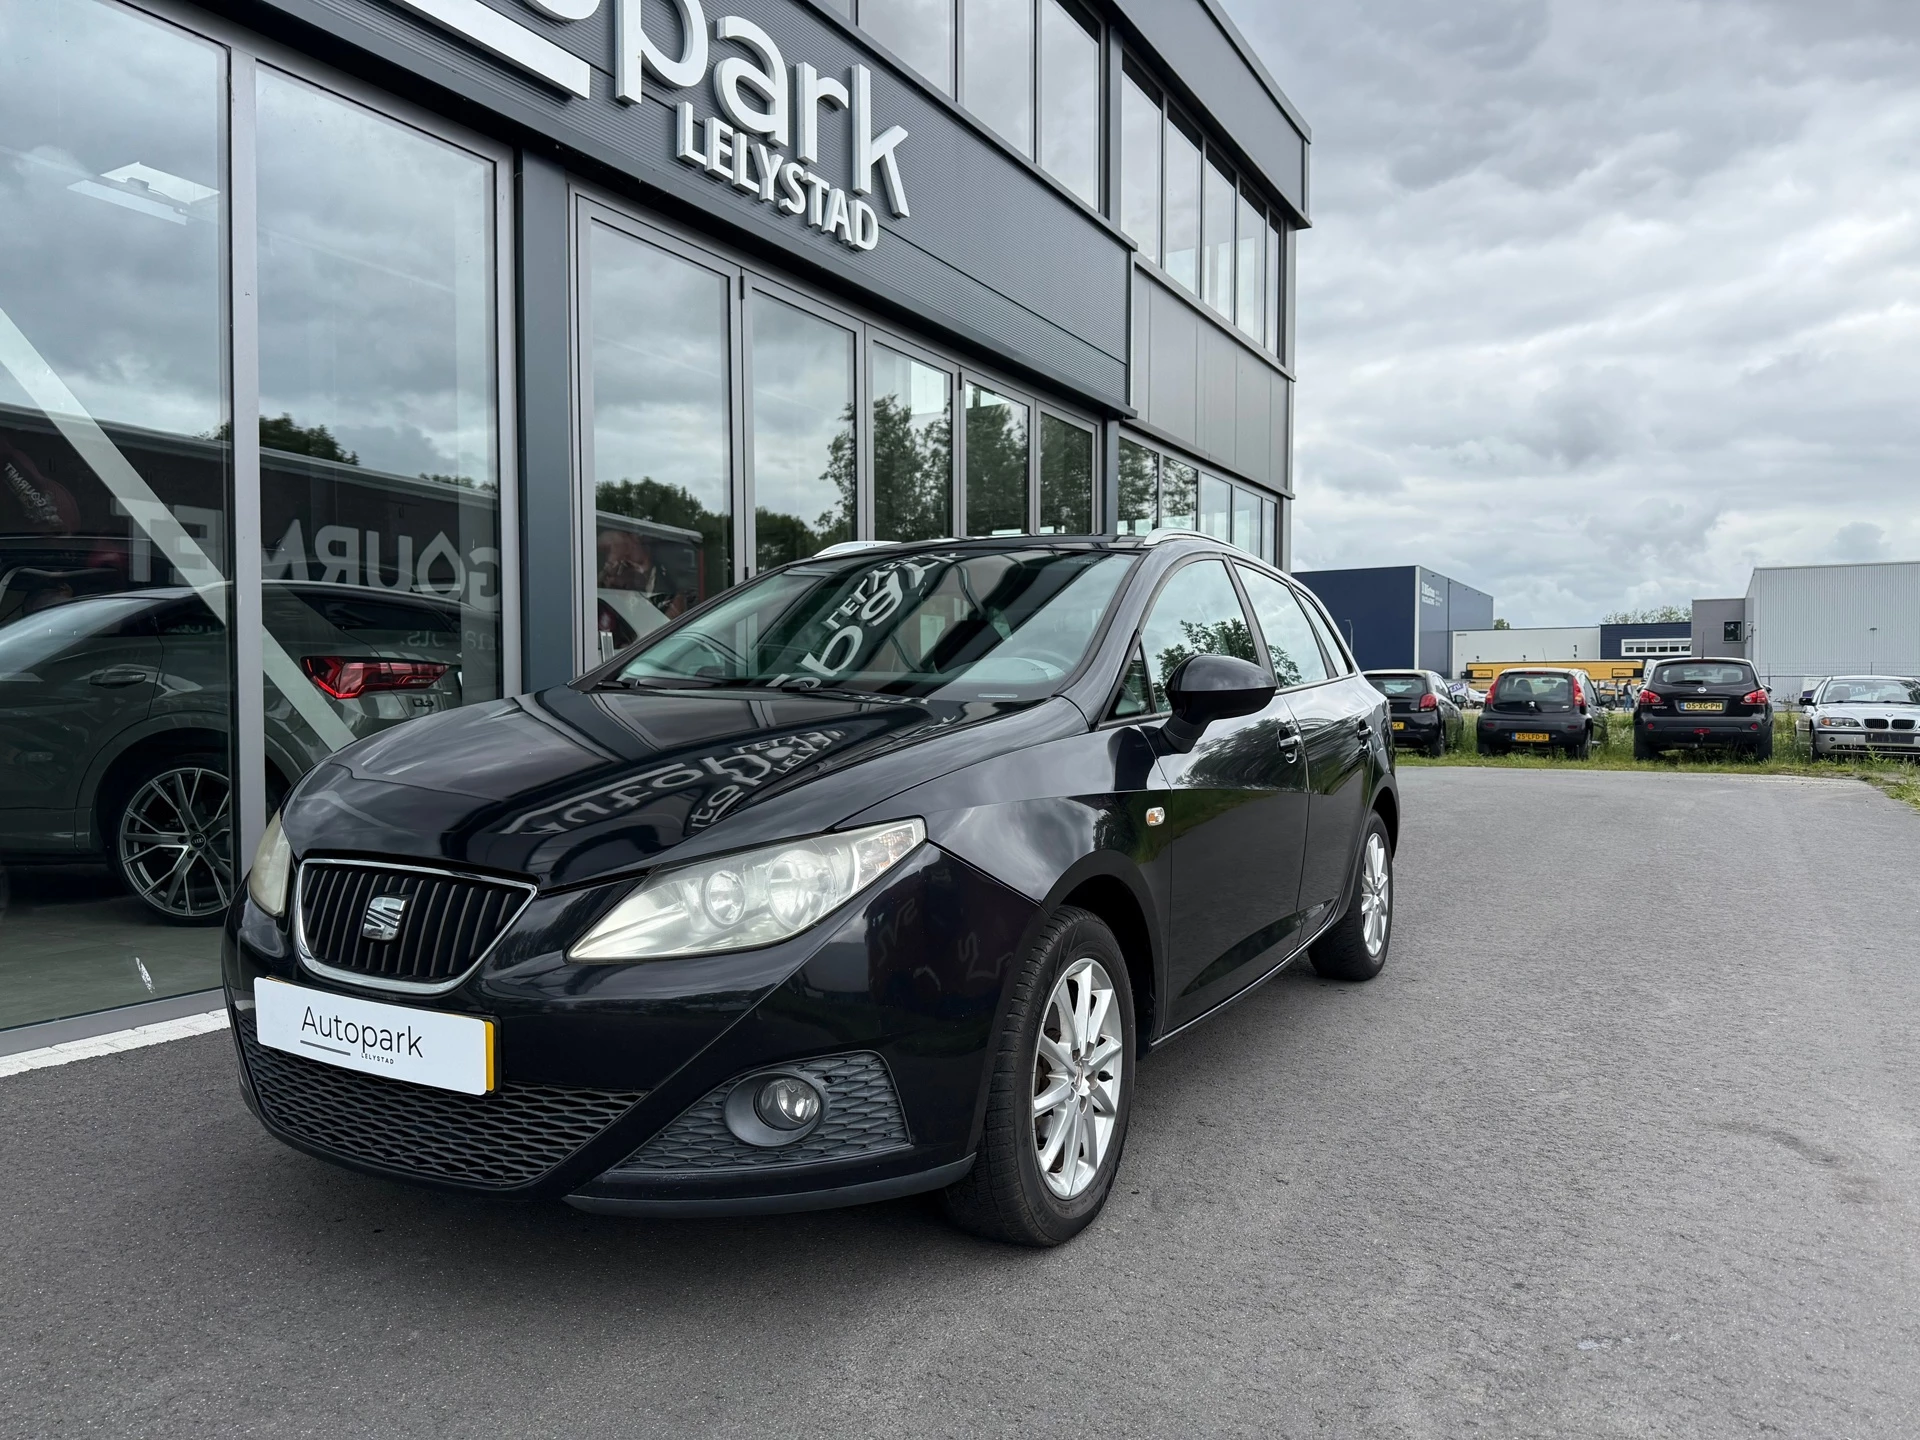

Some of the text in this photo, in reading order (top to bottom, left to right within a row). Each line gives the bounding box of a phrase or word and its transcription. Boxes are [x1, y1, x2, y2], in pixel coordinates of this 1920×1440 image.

[522, 0, 910, 218] park
[676, 102, 879, 251] LELYSTAD
[301, 1005, 424, 1059] Autopark
[360, 1052, 395, 1065] LELYSTAD
